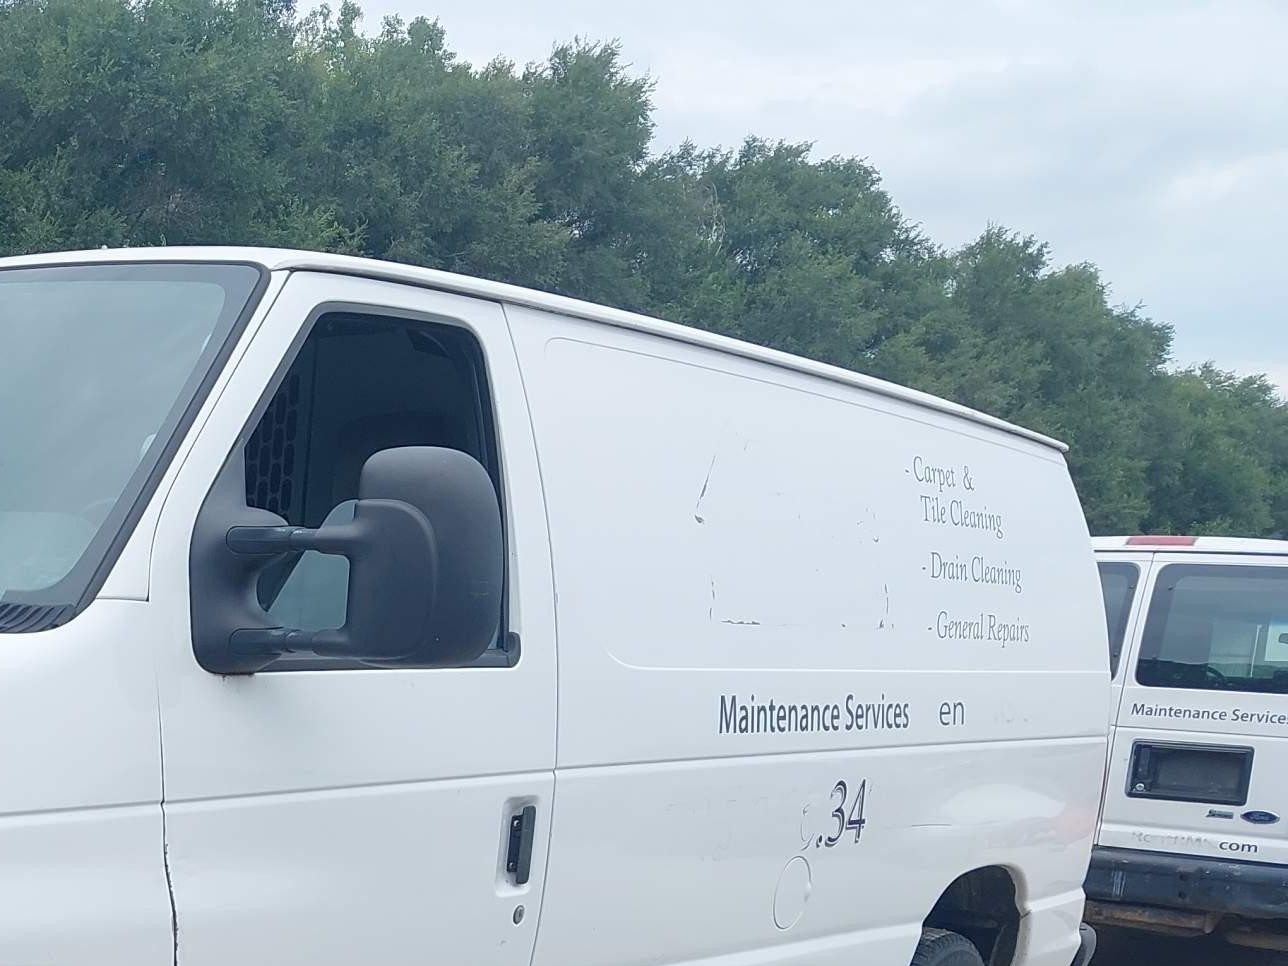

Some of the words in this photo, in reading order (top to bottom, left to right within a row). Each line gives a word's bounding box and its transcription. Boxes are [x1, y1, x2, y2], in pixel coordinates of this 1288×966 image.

[912, 455, 956, 492] Carpet
[962, 465, 974, 491] &
[920, 494, 946, 524] Tile
[949, 499, 1003, 539] Cleaning
[930, 551, 968, 582] Drain
[971, 556, 1022, 594] Cleaning
[936, 610, 984, 640] General
[987, 614, 1030, 649] Repairs
[718, 693, 840, 734] Maintenance
[845, 693, 910, 731] Services
[939, 701, 965, 726] en
[1130, 703, 1228, 721] Maintenance
[1230, 708, 1288, 725] Service
[1219, 841, 1258, 853] com
